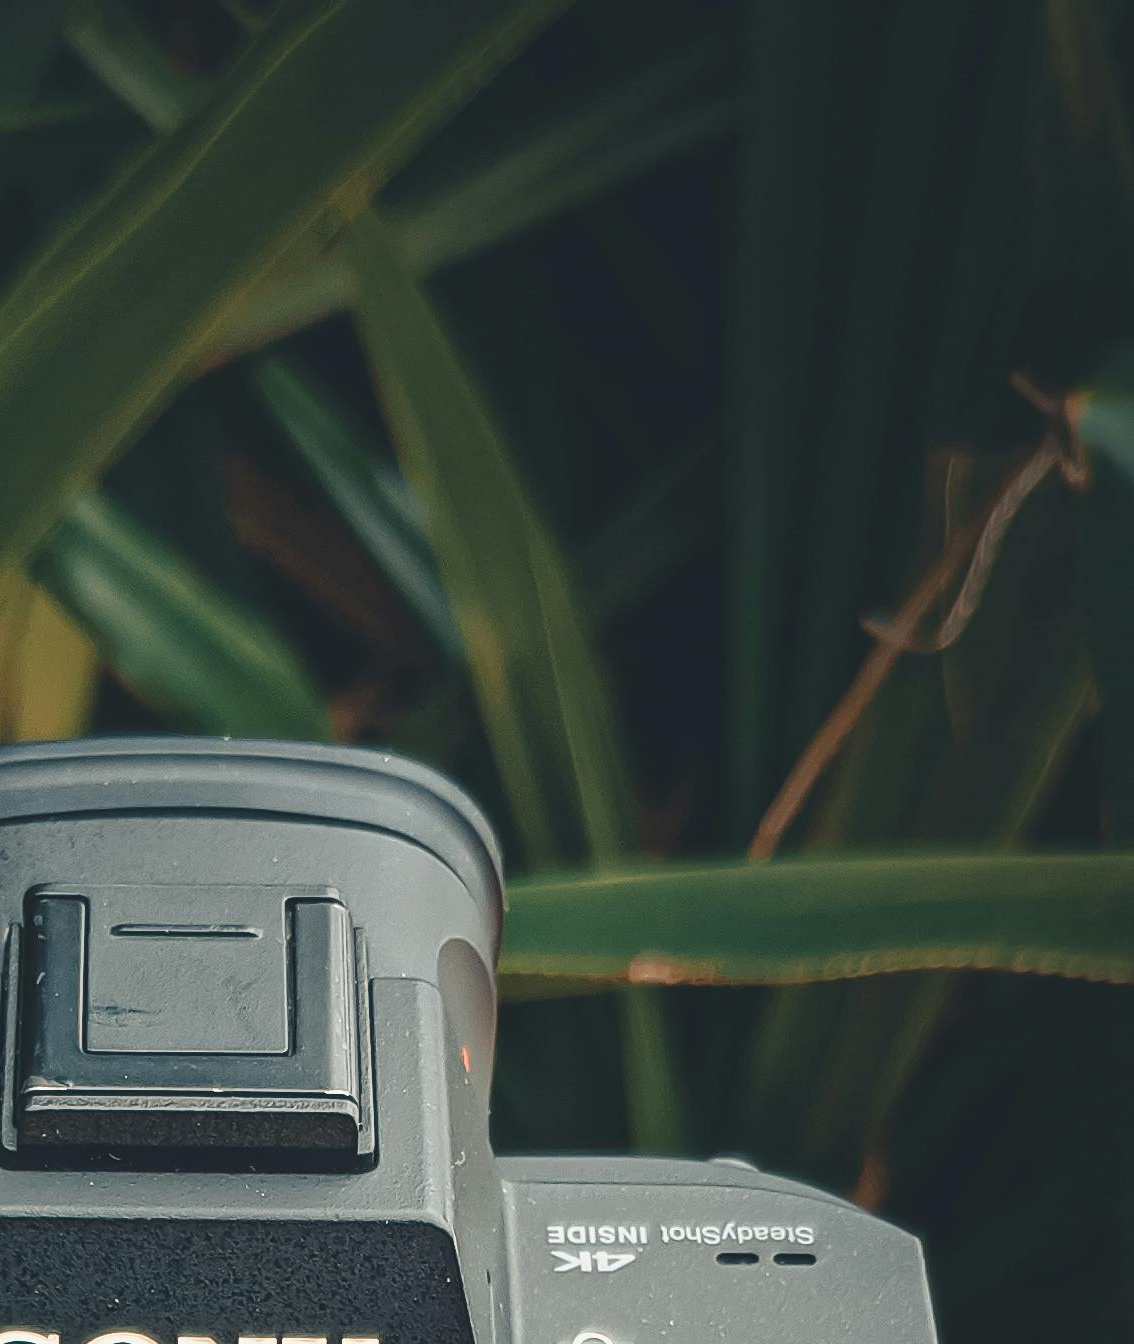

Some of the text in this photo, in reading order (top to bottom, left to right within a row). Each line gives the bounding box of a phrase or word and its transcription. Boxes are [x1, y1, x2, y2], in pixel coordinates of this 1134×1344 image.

[546, 1224, 815, 1246] SteadyShot INSIDE
[549, 1250, 637, 1273] 4K
